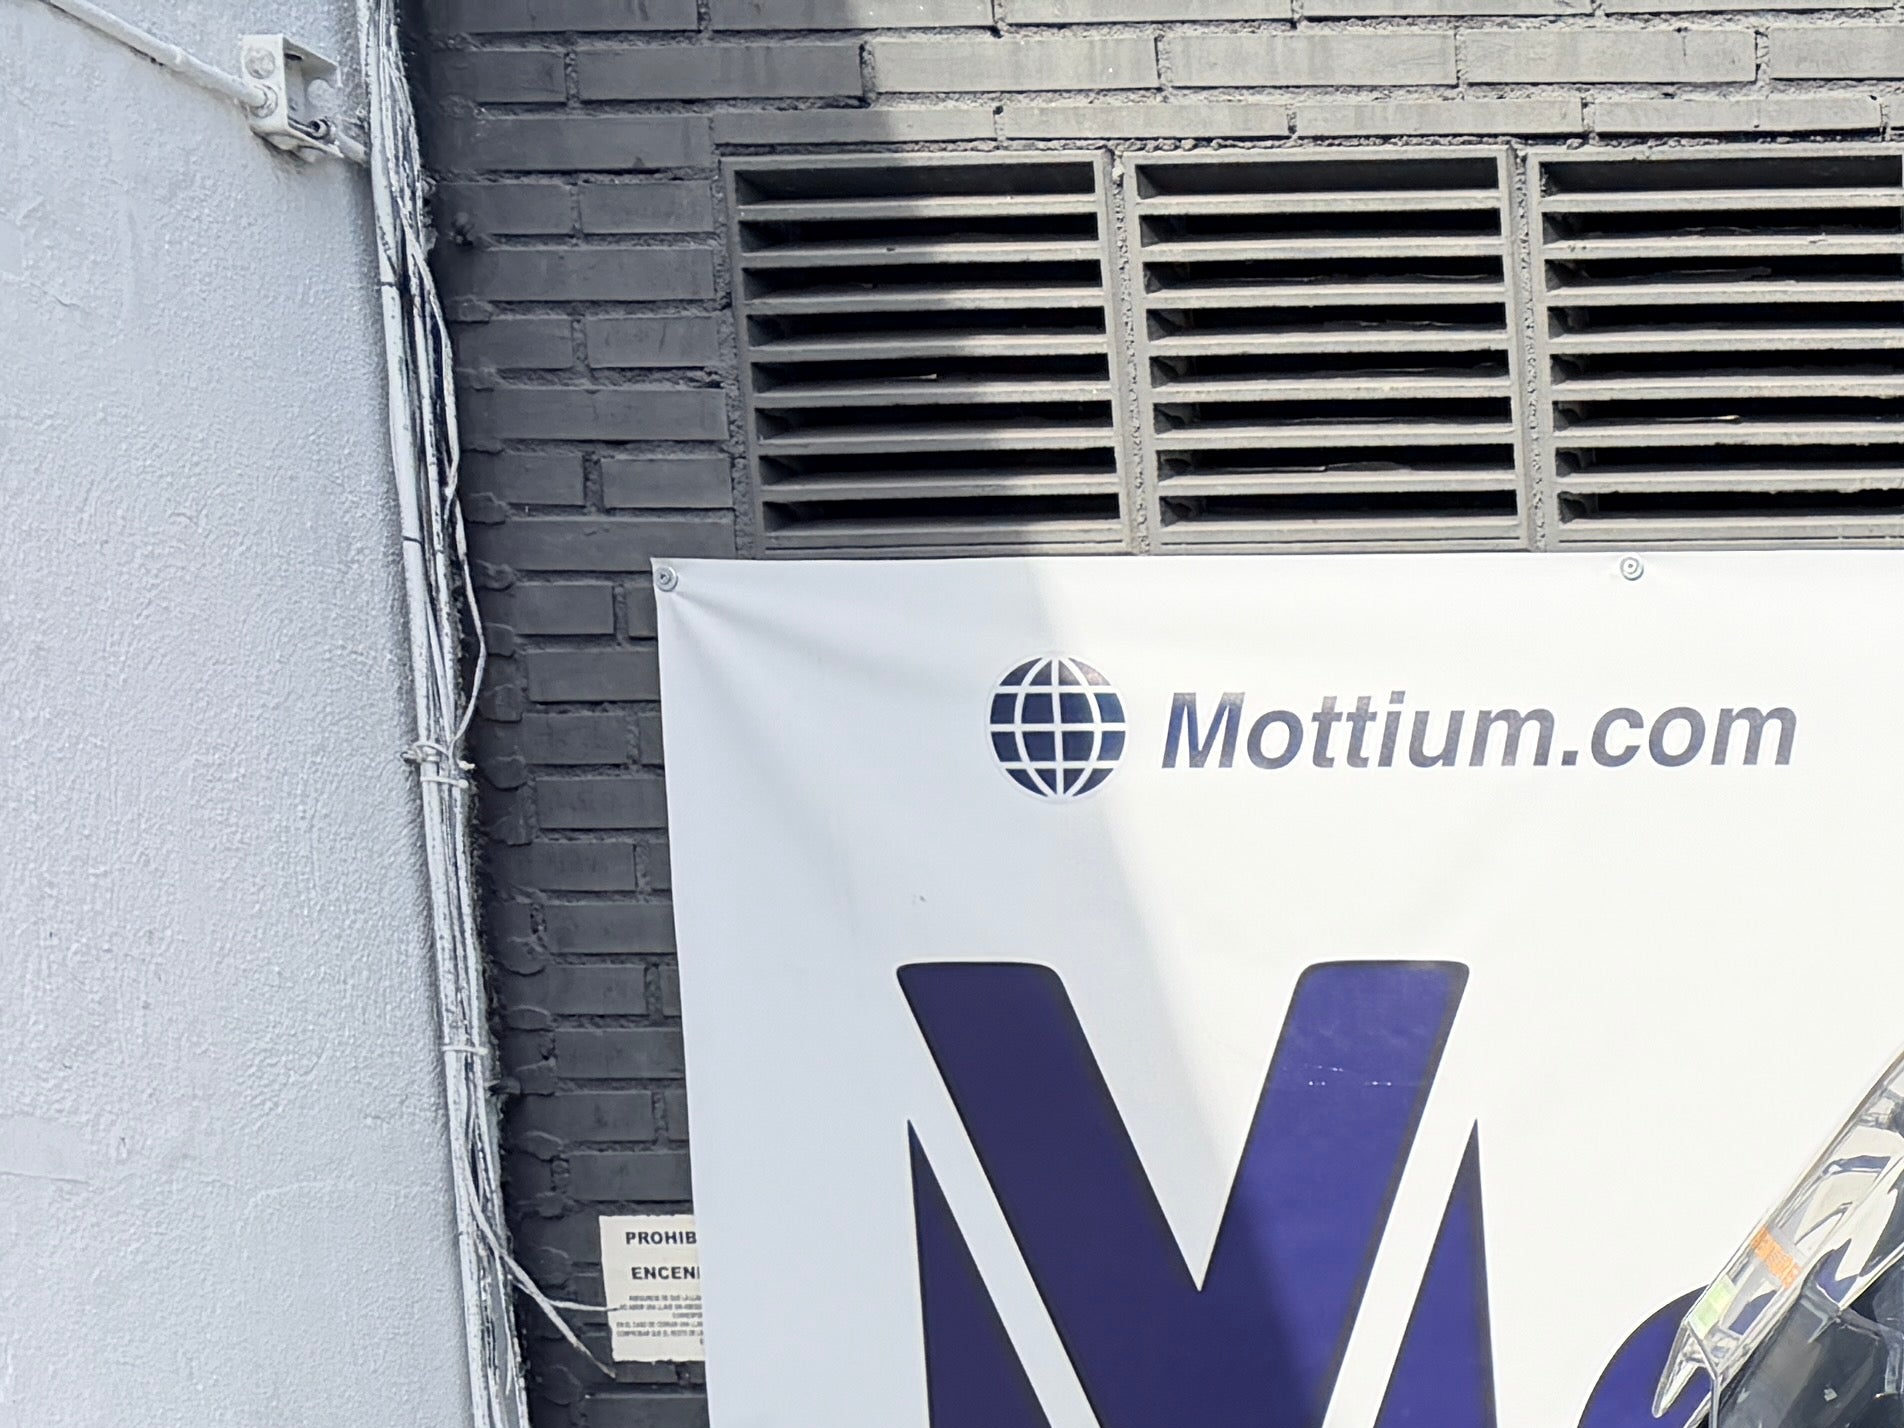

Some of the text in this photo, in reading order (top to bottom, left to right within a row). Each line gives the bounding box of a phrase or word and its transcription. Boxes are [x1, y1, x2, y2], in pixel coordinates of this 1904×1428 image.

[1161, 690, 1797, 770] Mottium.com
[626, 1231, 697, 1245] PROHIB
[631, 1266, 700, 1280] ENCEN
